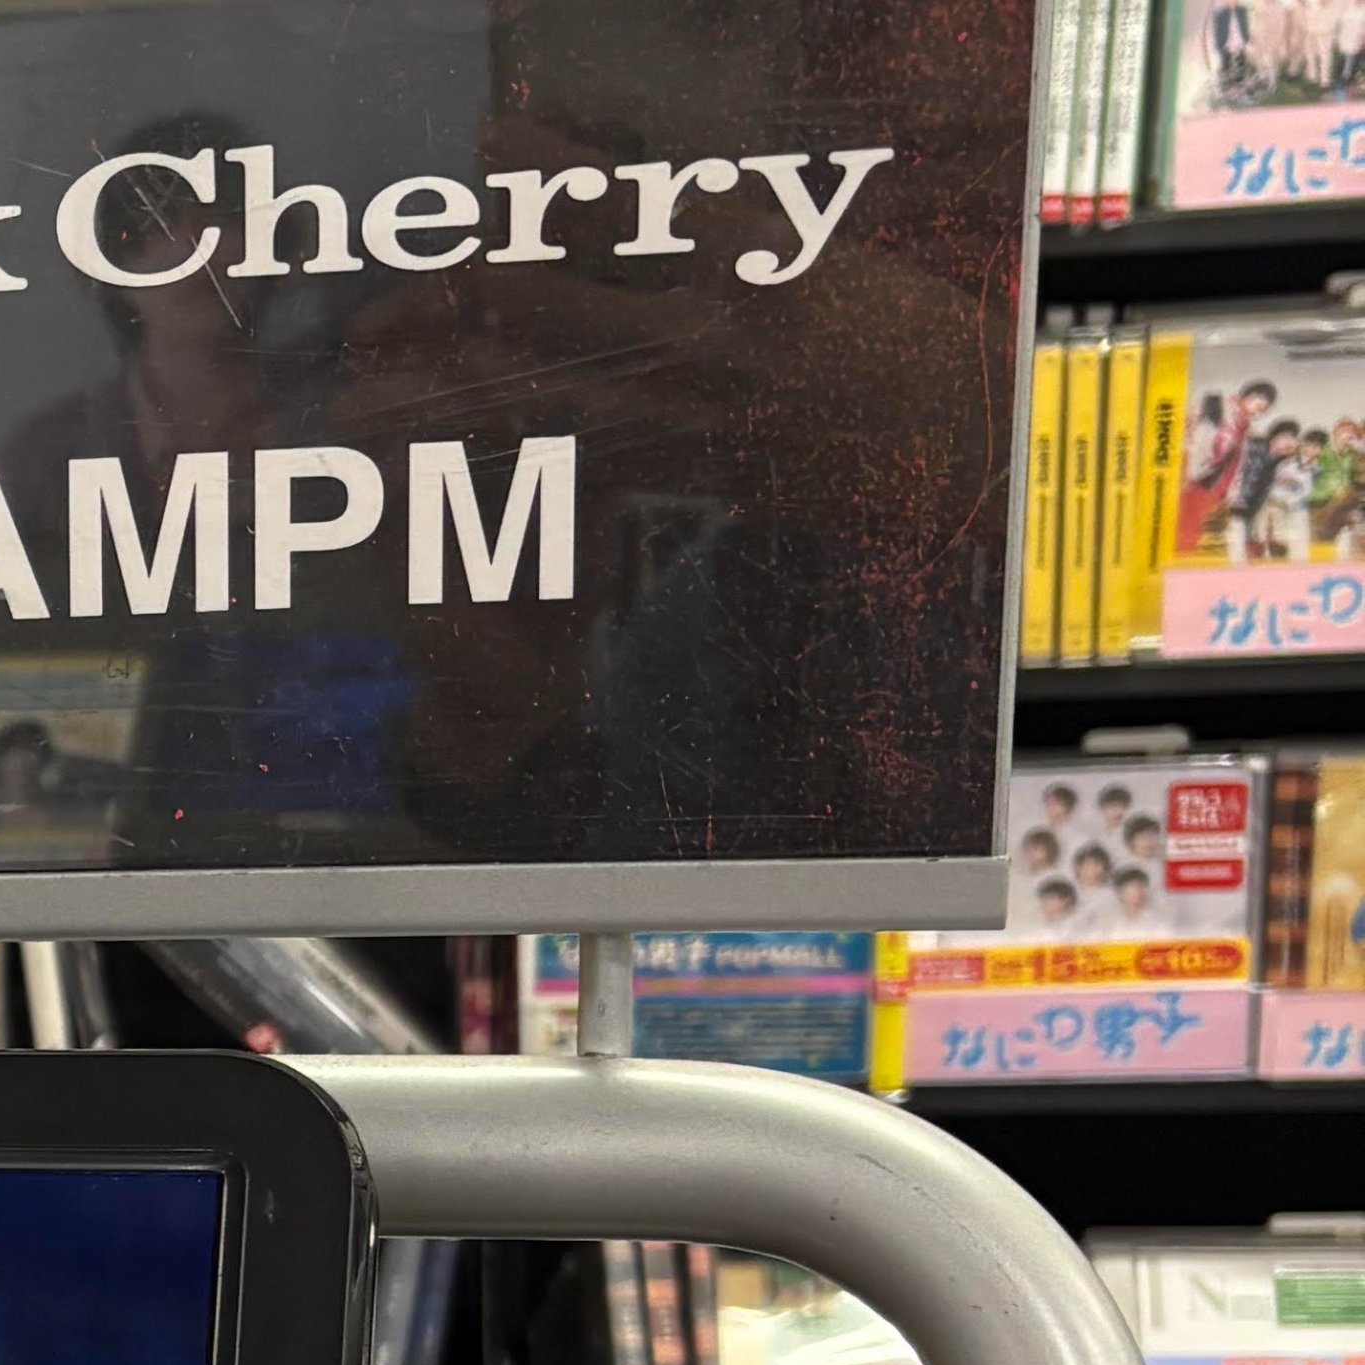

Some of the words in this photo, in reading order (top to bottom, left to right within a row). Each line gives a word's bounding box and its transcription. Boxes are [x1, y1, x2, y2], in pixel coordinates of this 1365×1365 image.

[54, 146, 895, 288] Cherry
[942, 991, 1201, 1072] なにわ男子
